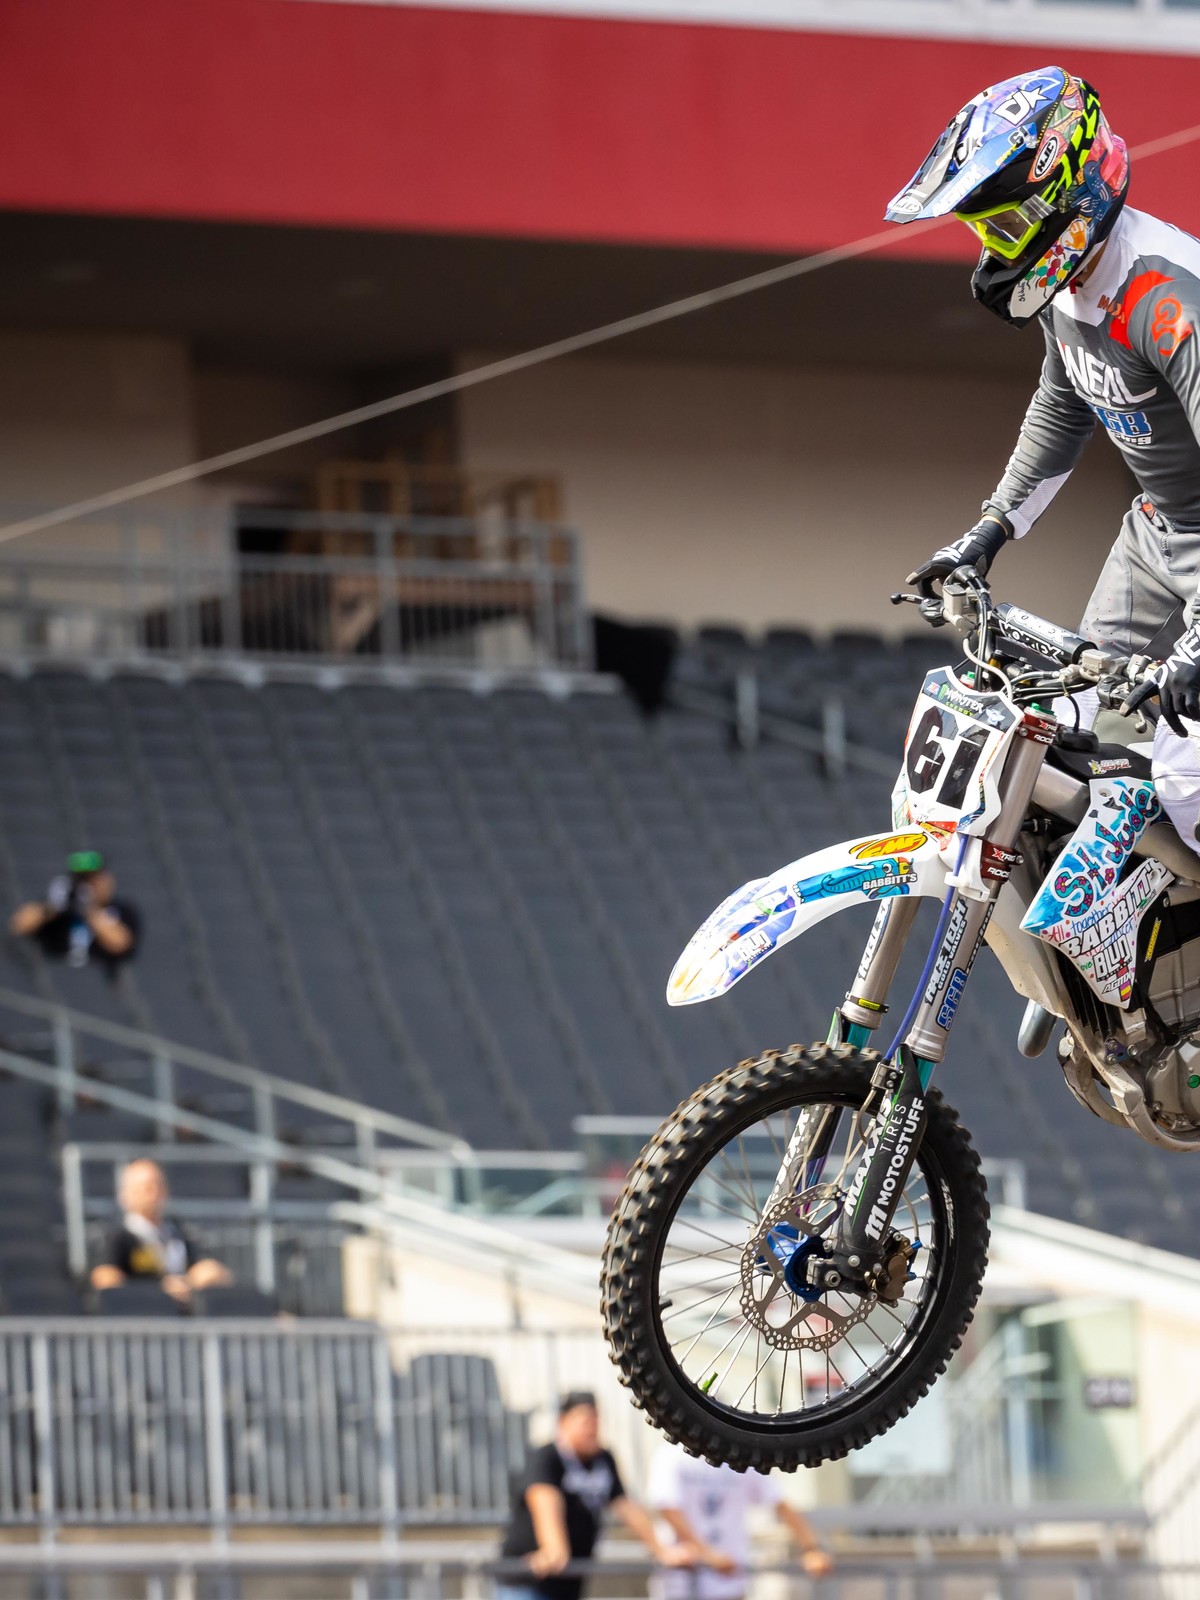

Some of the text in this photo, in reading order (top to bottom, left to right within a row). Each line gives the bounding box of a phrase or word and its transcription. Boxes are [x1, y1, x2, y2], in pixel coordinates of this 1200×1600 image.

[1037, 141, 1056, 175] HJC
[907, 705, 991, 810] 61
[862, 872, 918, 891] BABBITT'S
[1059, 859, 1172, 959] BABBITT'S
[925, 899, 967, 1005] RACE TECH
[938, 919, 967, 990] GOLD VALVES
[844, 1094, 893, 1217] MAXXIS
[876, 1096, 924, 1206] MOTOSTUFF
[880, 1102, 906, 1152] TIRES
